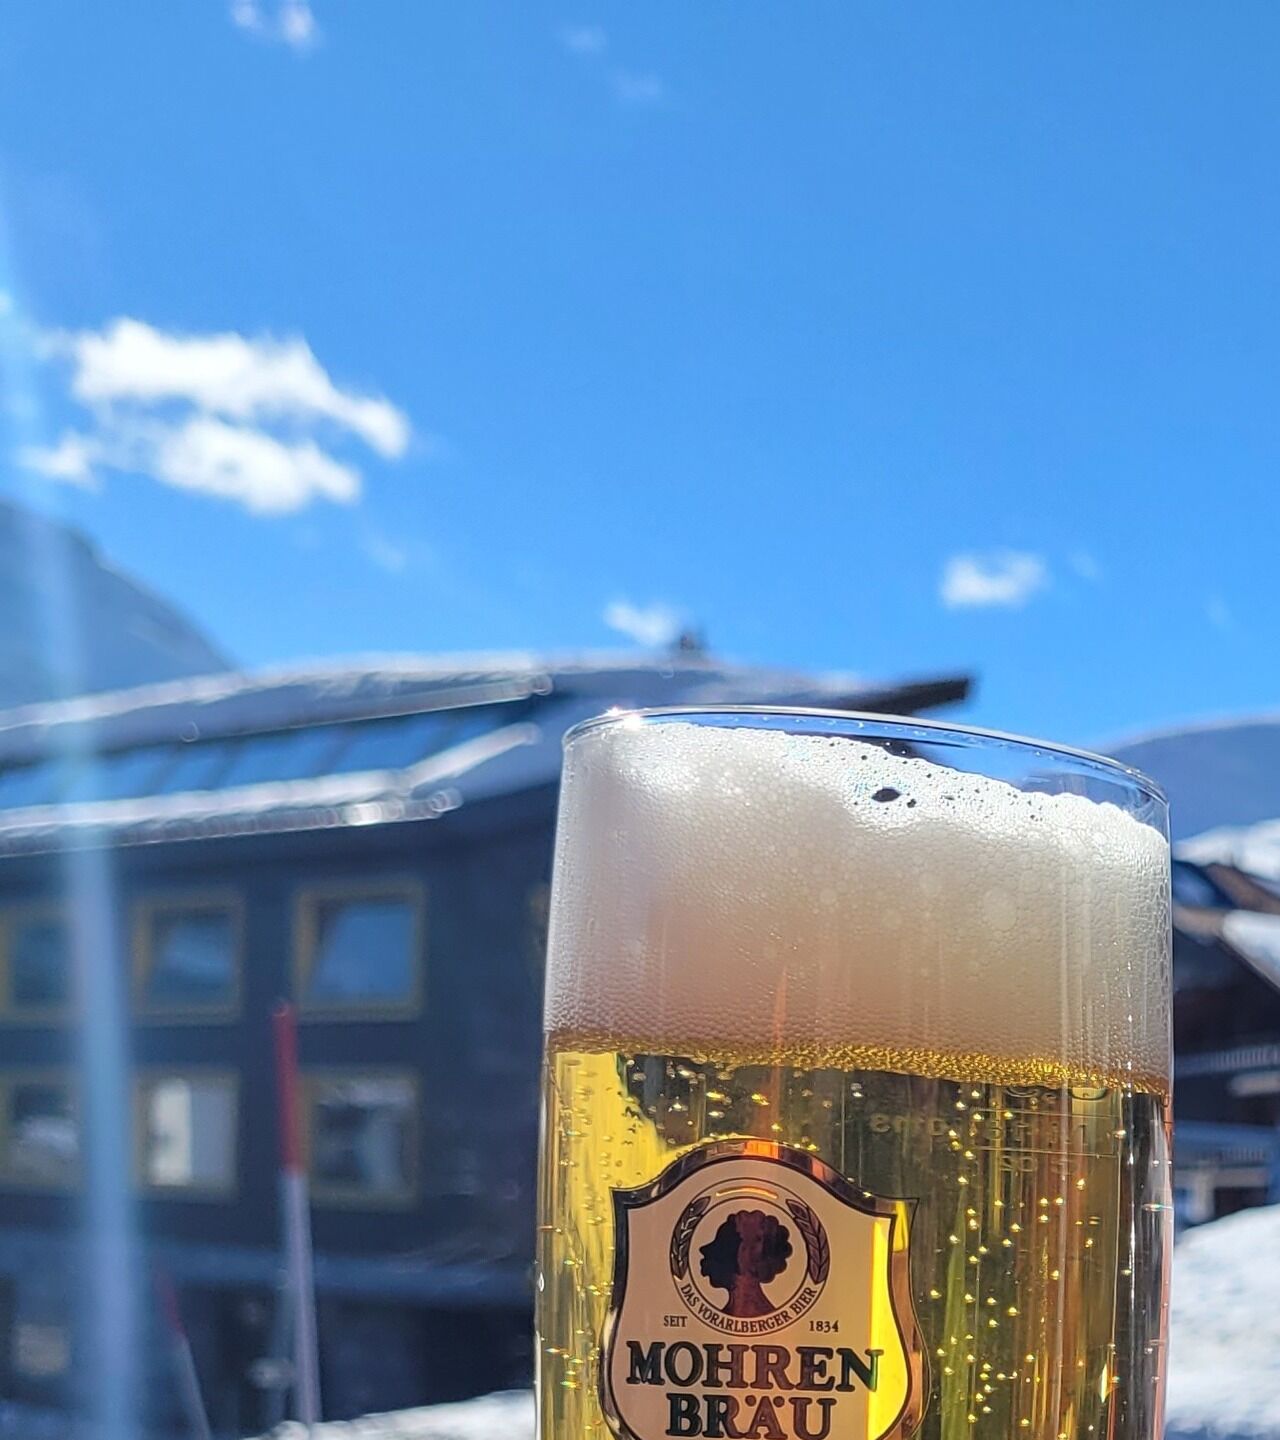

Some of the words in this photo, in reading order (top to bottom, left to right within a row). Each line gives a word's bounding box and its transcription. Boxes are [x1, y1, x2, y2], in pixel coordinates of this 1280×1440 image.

[663, 1315, 687, 1328] SEIT
[809, 1320, 839, 1333] 1834
[680, 1283, 699, 1308] DAS
[698, 1305, 793, 1333] VORARLBERGER
[792, 1287, 817, 1314] BIER
[626, 1341, 884, 1392] MOHREN
